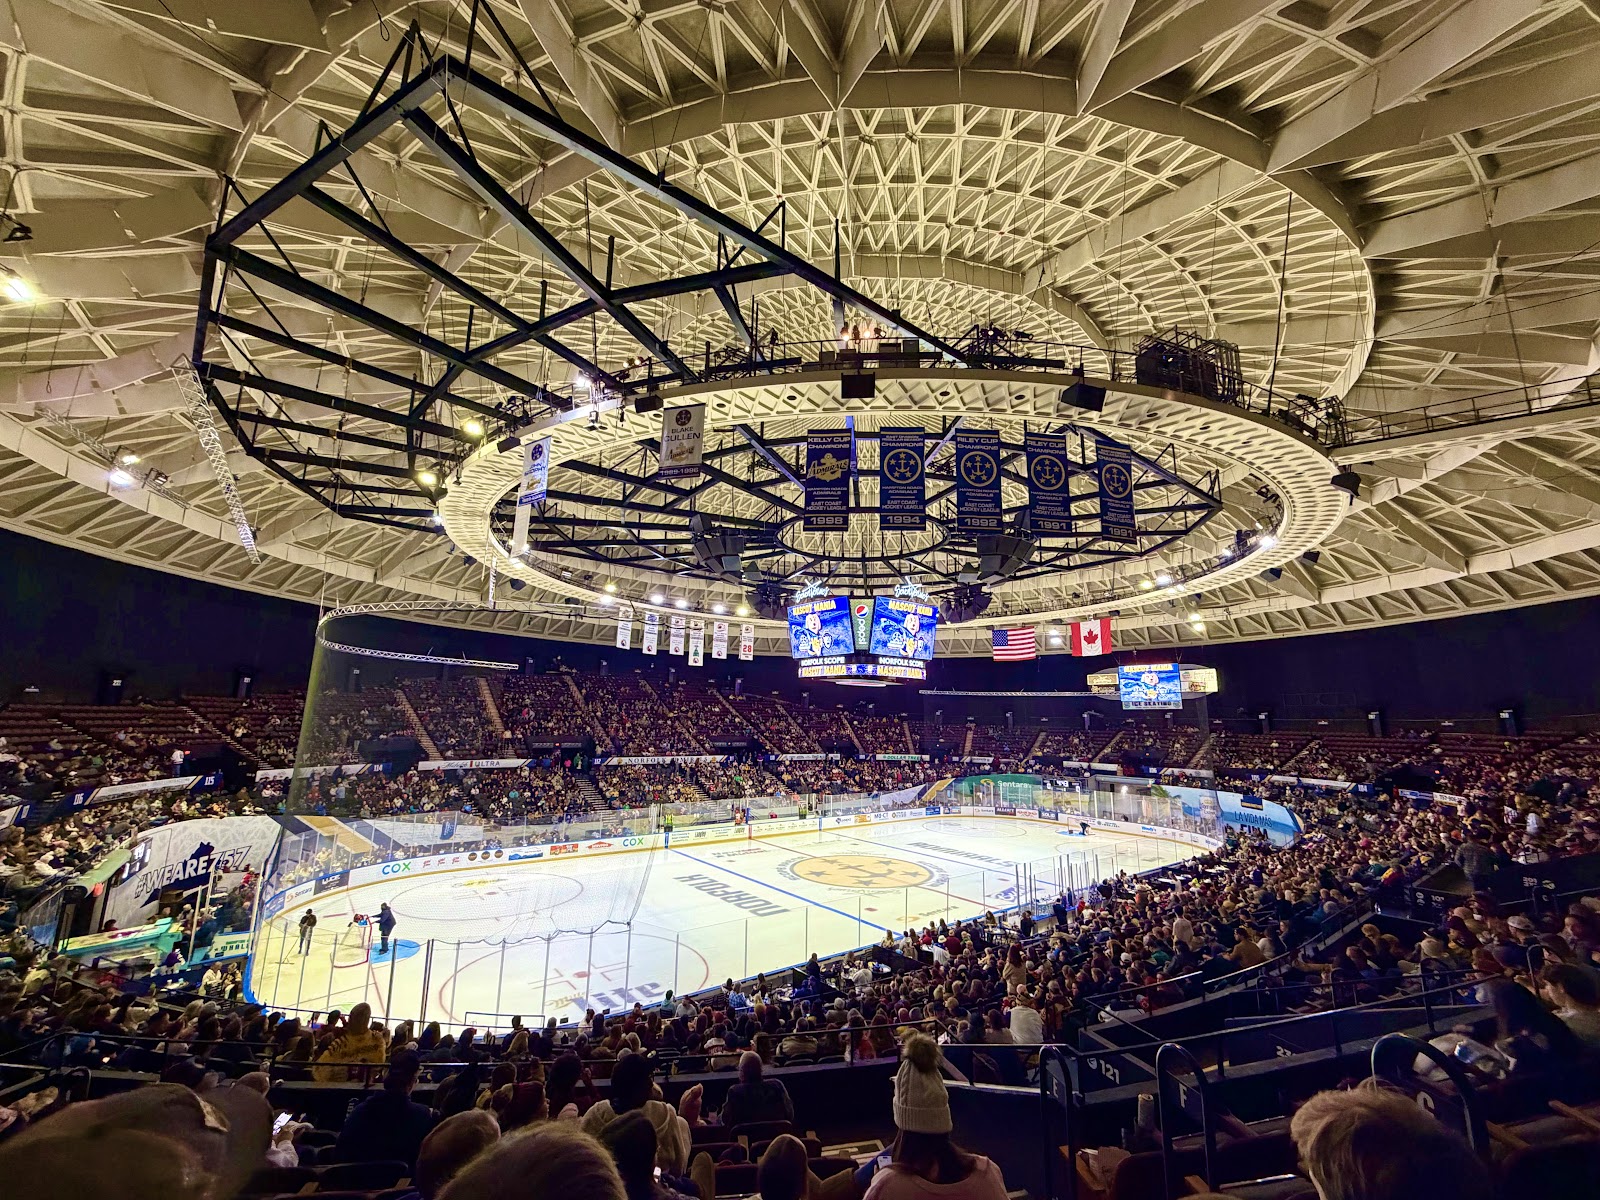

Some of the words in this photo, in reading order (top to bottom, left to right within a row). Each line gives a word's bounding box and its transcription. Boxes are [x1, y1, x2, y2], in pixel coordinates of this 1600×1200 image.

[671, 426, 694, 434] BLAKE
[664, 432, 701, 443] CULLEN
[1027, 447, 1065, 455] CHAMPIONS
[1098, 455, 1131, 464] CHAMPIONS
[810, 517, 843, 525] 1998
[887, 515, 920, 524] 1994
[964, 518, 998, 527] 1992
[1037, 520, 1067, 530] 1991
[1108, 527, 1133, 537] 1991
[888, 601, 916, 613] MASCOT
[858, 619, 867, 645] pepsi
[800, 657, 823, 667] NORFOLK
[824, 657, 845, 665] SCOPE
[879, 657, 909, 667] NORFOLK
[909, 659, 924, 668] SCOPE
[824, 665, 847, 675] MANIA
[877, 666, 905, 676] MASCOT
[374, 764, 383, 772] 114
[205, 776, 215, 786] 115
[997, 780, 1030, 788] Sentara
[1234, 811, 1249, 822] LA
[1248, 812, 1265, 824] VIDA
[1264, 814, 1278, 828] MÁS
[622, 837, 644, 847] COX
[382, 861, 412, 875] COX
[1099, 1059, 1120, 1085] 121
[1179, 1082, 1187, 1109] F
